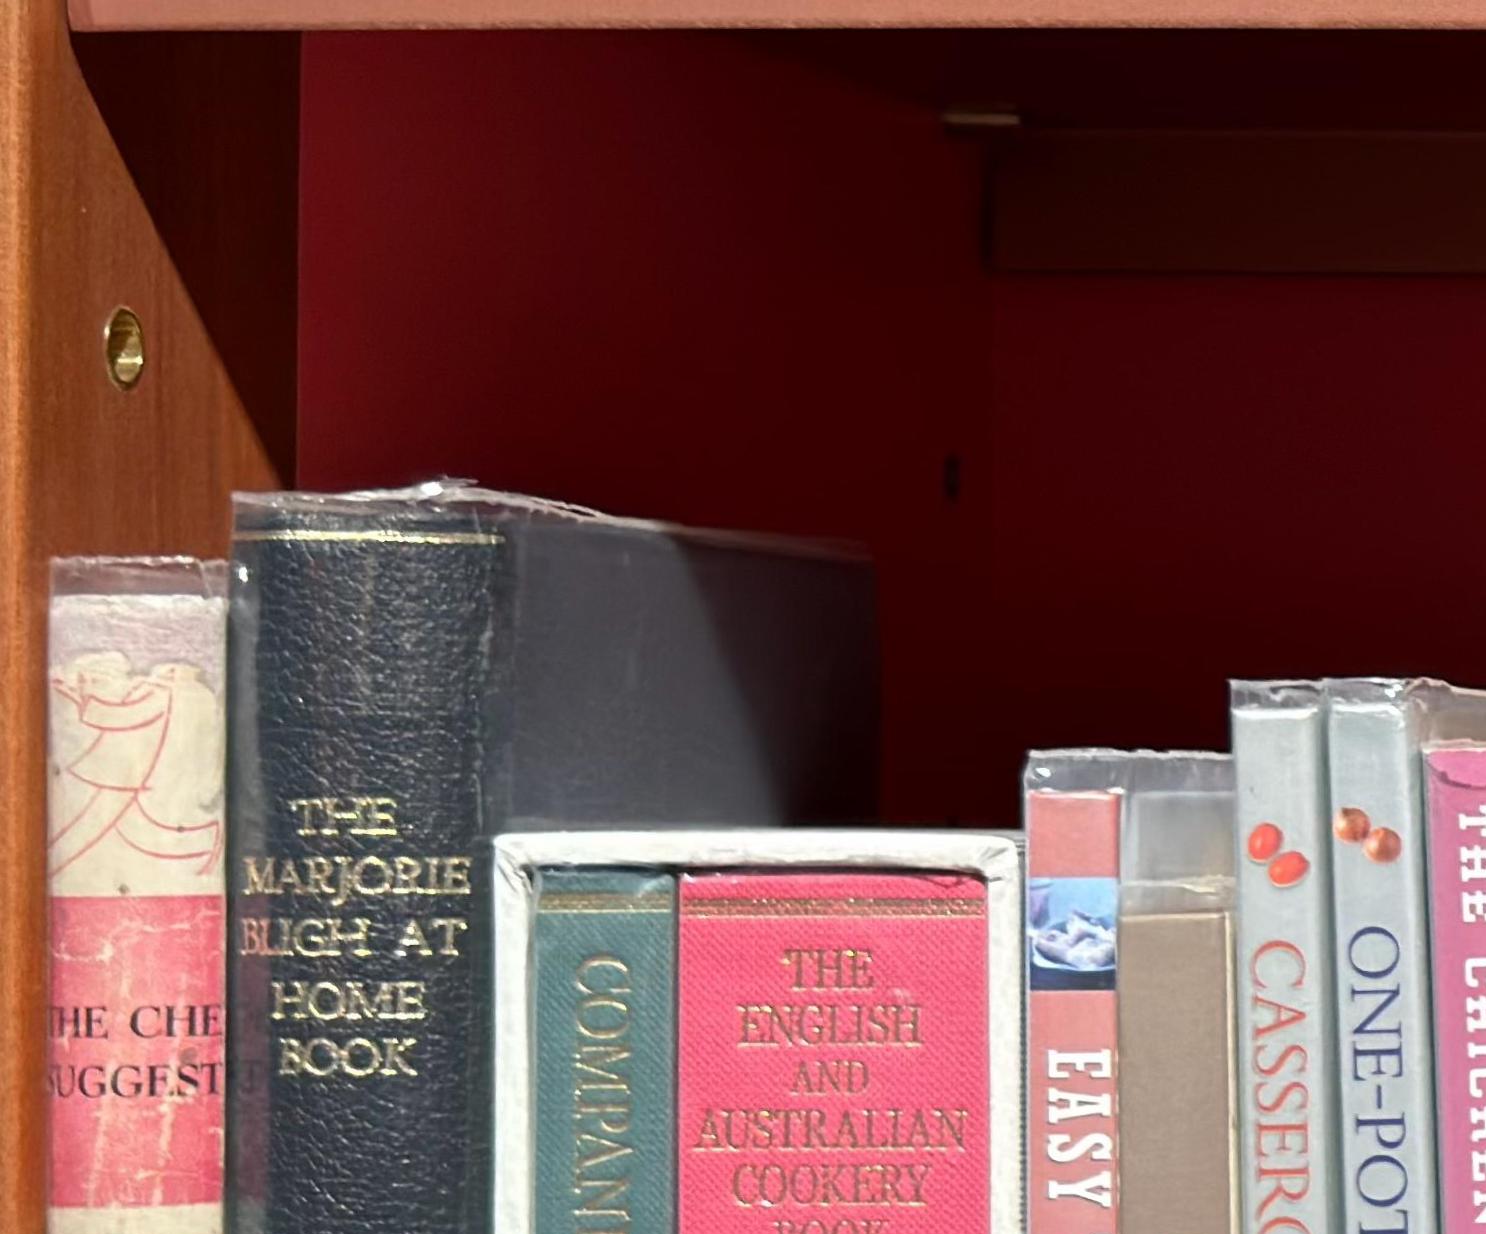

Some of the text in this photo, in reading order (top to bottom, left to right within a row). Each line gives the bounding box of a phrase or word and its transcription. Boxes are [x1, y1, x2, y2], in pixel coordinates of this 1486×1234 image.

[289, 798, 403, 839] THE
[244, 855, 471, 908] MARJORIE
[240, 916, 468, 958] BLIGH AT
[782, 948, 875, 992] THE
[270, 980, 427, 1023] HOME
[736, 1004, 922, 1049] ENGLISH
[279, 1037, 419, 1079] BOOK
[789, 1060, 869, 1096] AND
[691, 1108, 969, 1152] AUSTRALIAN
[1045, 1049, 1112, 1208] EASY
[731, 1163, 932, 1207] COOKERY
